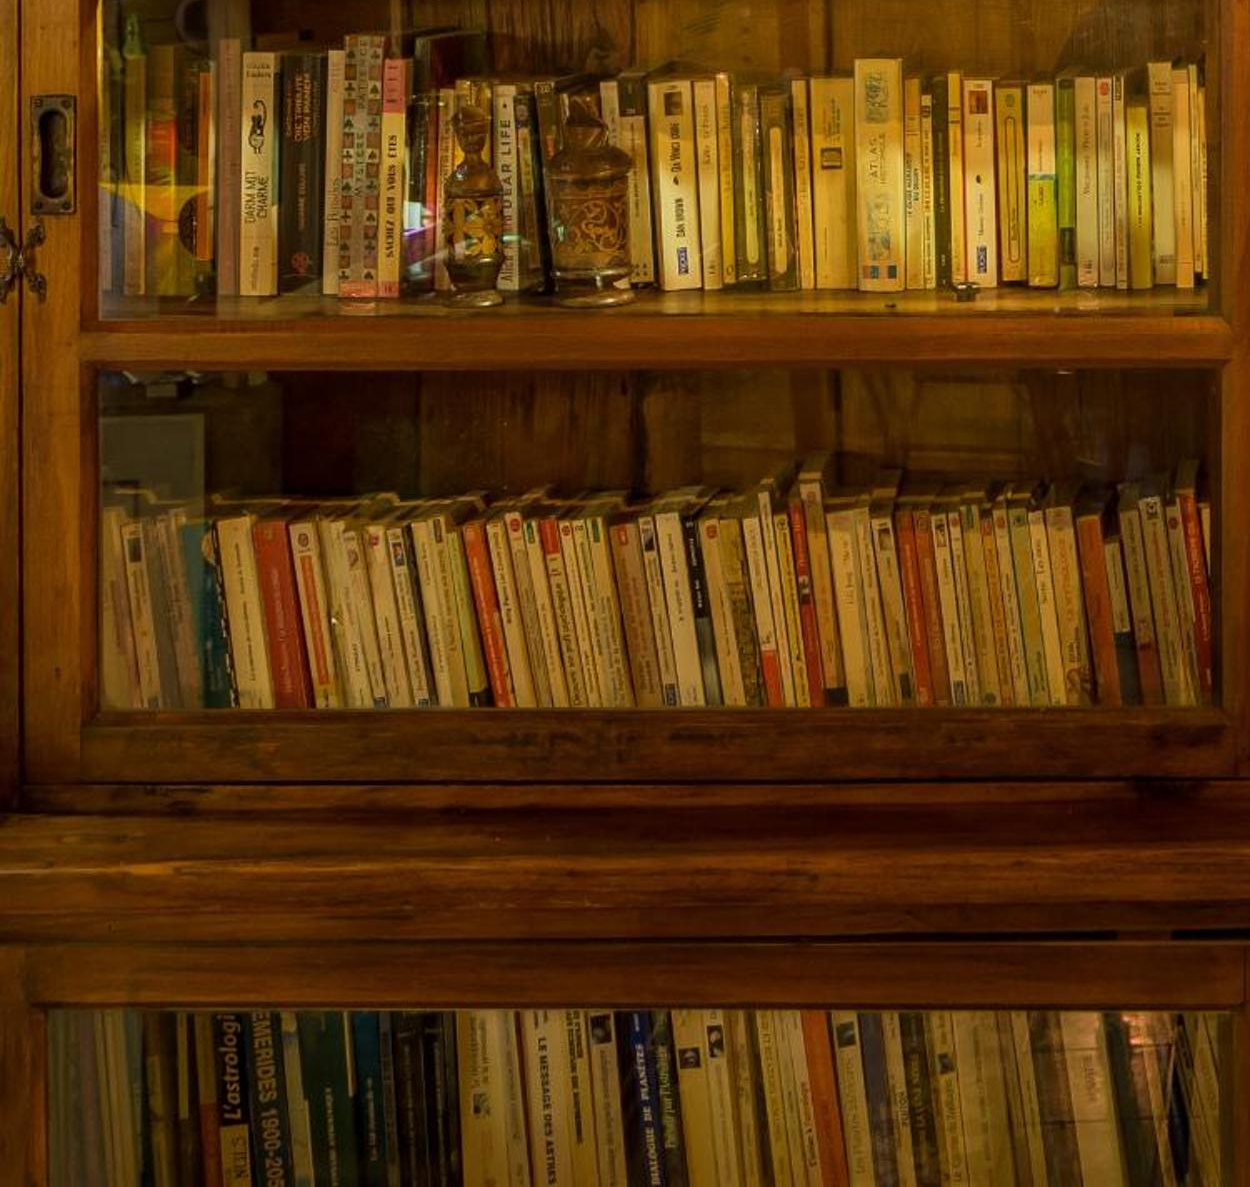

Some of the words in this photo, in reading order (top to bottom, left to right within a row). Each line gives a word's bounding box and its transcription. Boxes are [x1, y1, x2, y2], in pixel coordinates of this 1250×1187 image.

[499, 119, 512, 156] LIFE
[257, 177, 269, 219] CHARME
[217, 1014, 242, 1120] L'astrologi
[252, 1011, 277, 1103] EMERIDES
[537, 1037, 548, 1052] LE
[539, 1055, 552, 1111] MESSAGE
[261, 1107, 285, 1187] 1900-205
[545, 1139, 557, 1184] ASTRES
